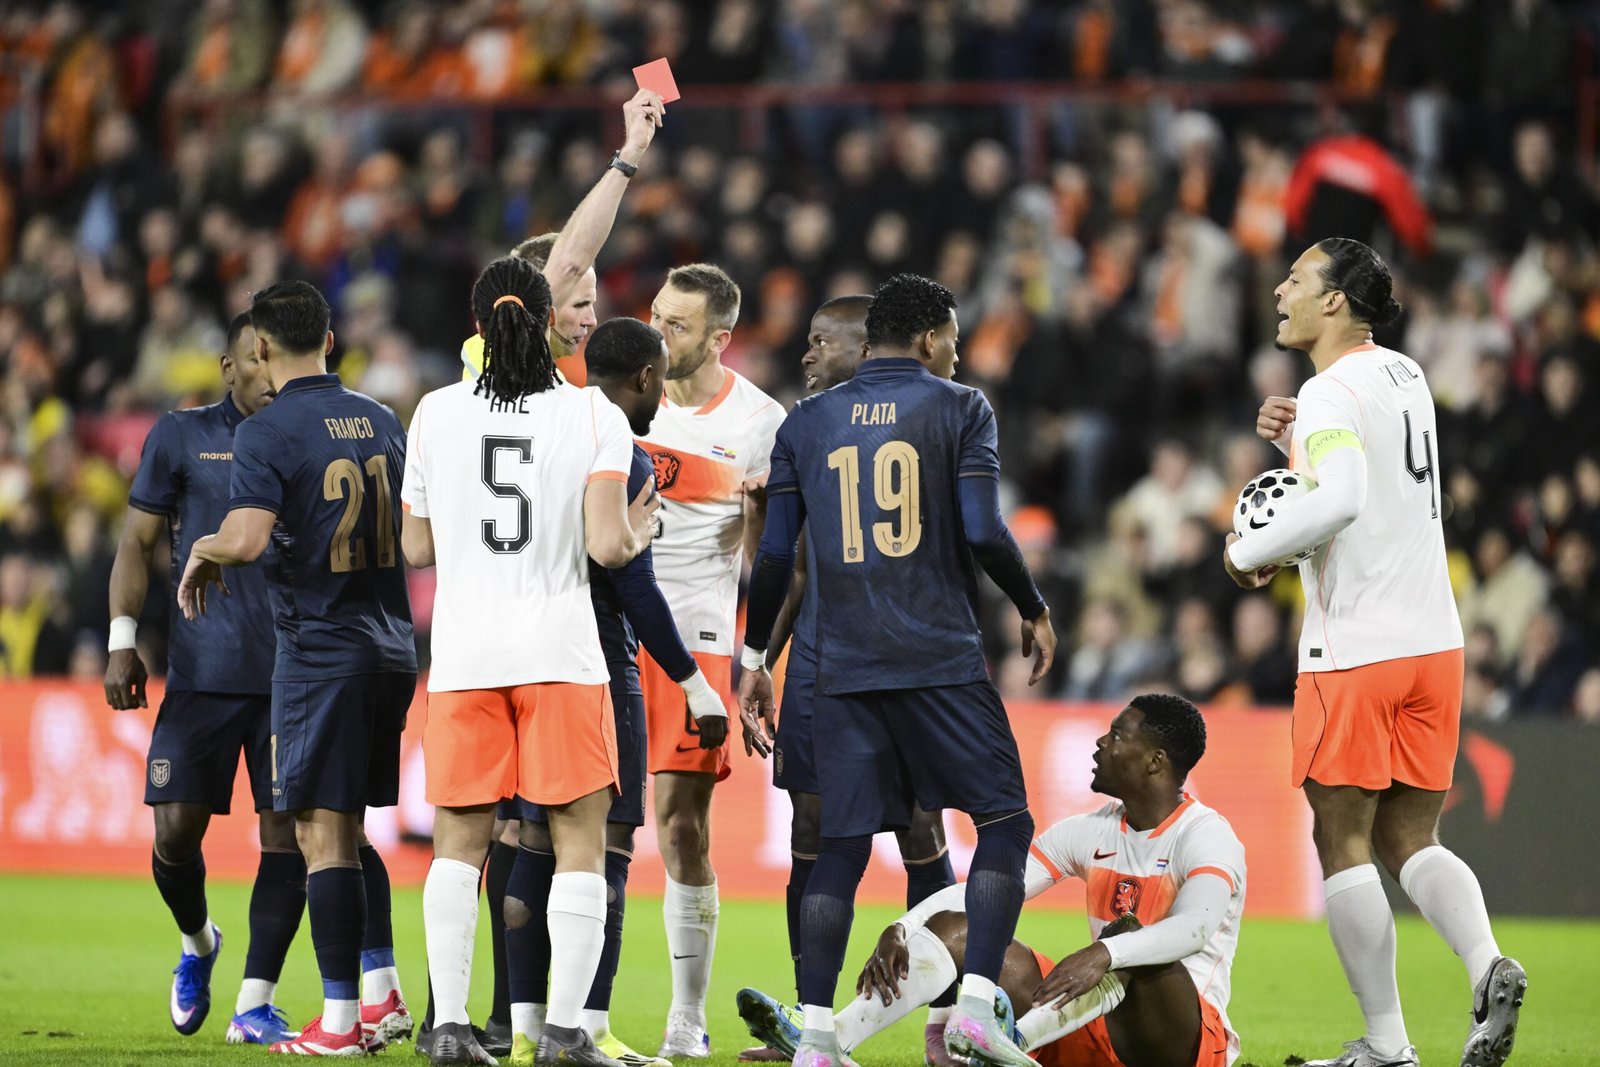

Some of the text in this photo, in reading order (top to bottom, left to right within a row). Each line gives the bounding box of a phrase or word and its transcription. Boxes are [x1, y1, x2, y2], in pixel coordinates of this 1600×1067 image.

[324, 416, 374, 440] FRANCO
[851, 402, 896, 425] PLATA
[1402, 410, 1438, 519] 4
[323, 455, 396, 573] 21
[481, 435, 534, 554] 5
[827, 440, 922, 563] 19
